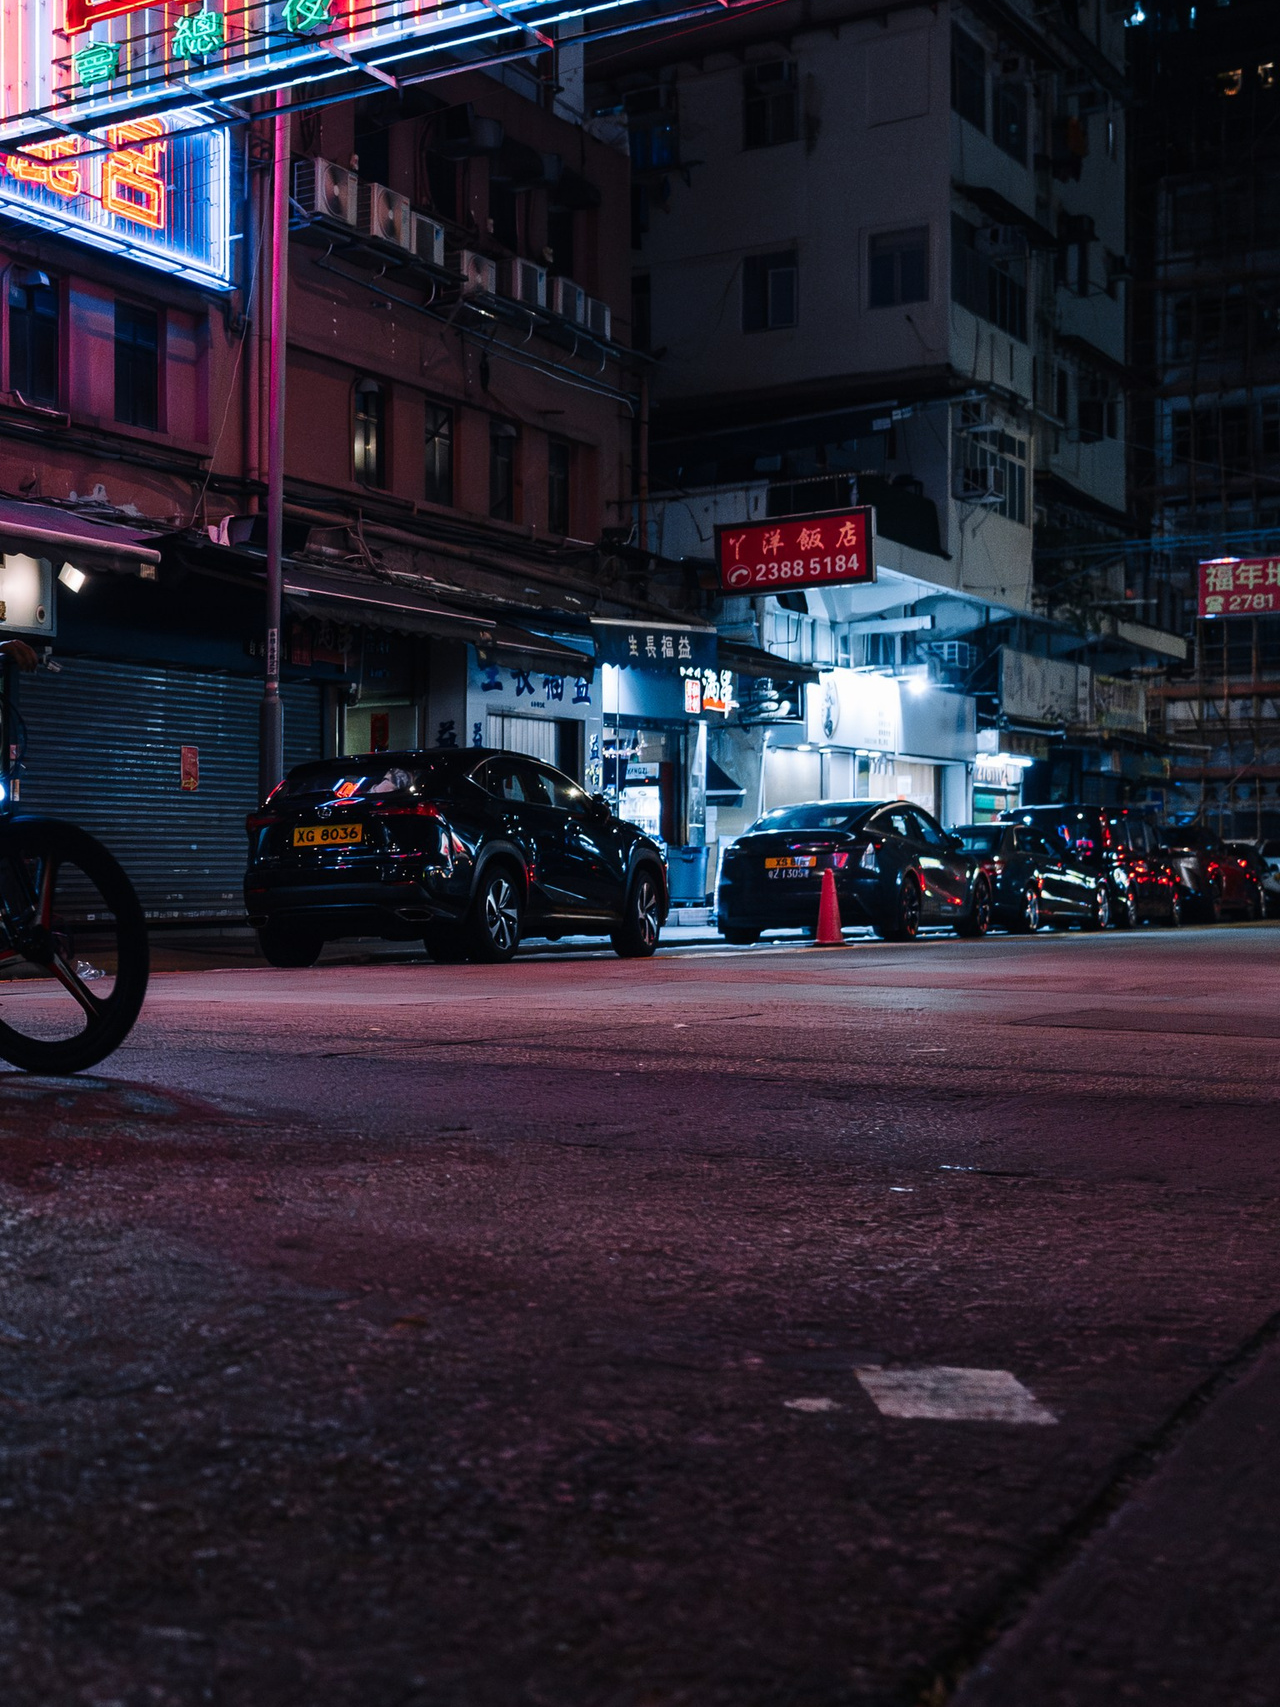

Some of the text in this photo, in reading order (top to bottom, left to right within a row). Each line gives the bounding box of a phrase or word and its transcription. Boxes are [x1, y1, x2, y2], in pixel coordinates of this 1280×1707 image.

[755, 553, 859, 581] 2388 5184
[1229, 594, 1274, 611] 2781
[295, 824, 360, 843] XG 8036
